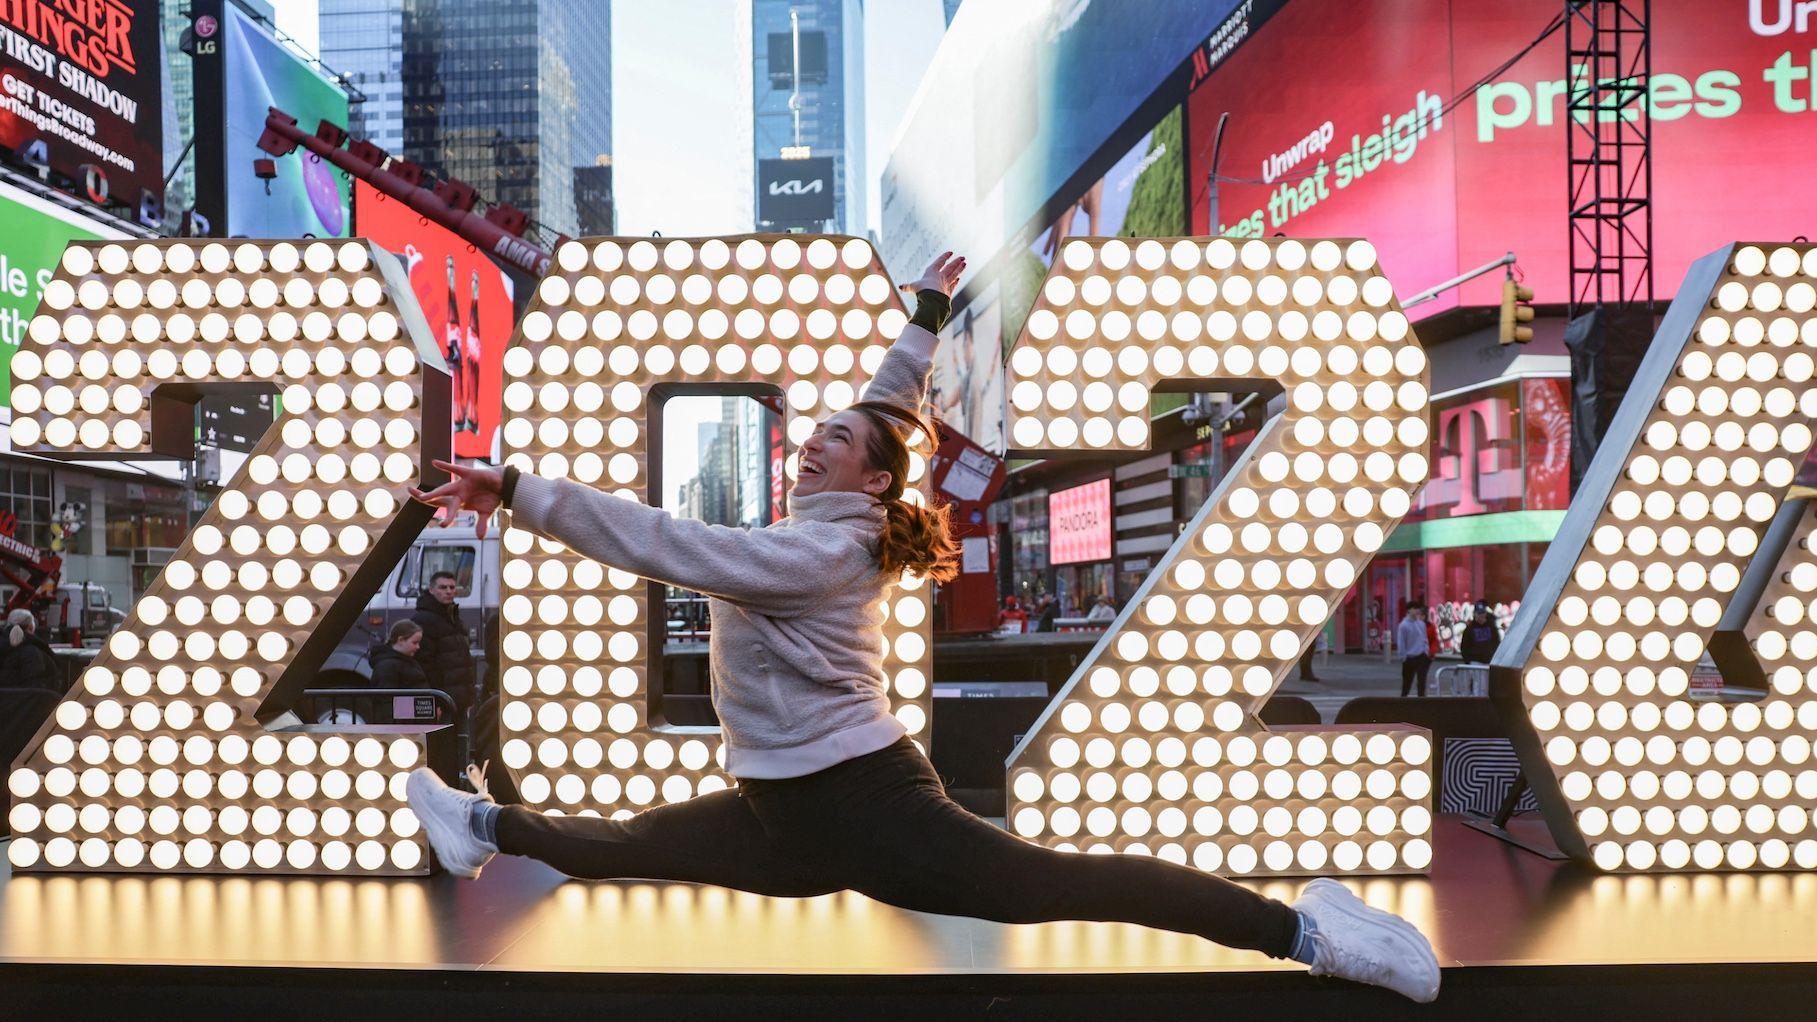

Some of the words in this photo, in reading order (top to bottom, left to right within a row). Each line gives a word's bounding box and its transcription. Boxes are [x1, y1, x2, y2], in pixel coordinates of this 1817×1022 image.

[54, 0, 136, 65] GER
[197, 40, 216, 54] LG
[1209, 0, 1253, 49] MARRIOTT
[1209, 21, 1249, 68] MARQUIS
[2, 74, 35, 105] GET
[37, 90, 96, 136] TICKETS
[59, 61, 138, 124] SHADOW
[1476, 63, 1743, 142] prizes
[1763, 49, 1817, 113] t
[1262, 121, 1334, 184] Unwrap
[1268, 159, 1330, 228] that
[1335, 89, 1443, 190] sleigh
[494, 235, 537, 270] AMA
[1059, 511, 1099, 533] PANDORA
